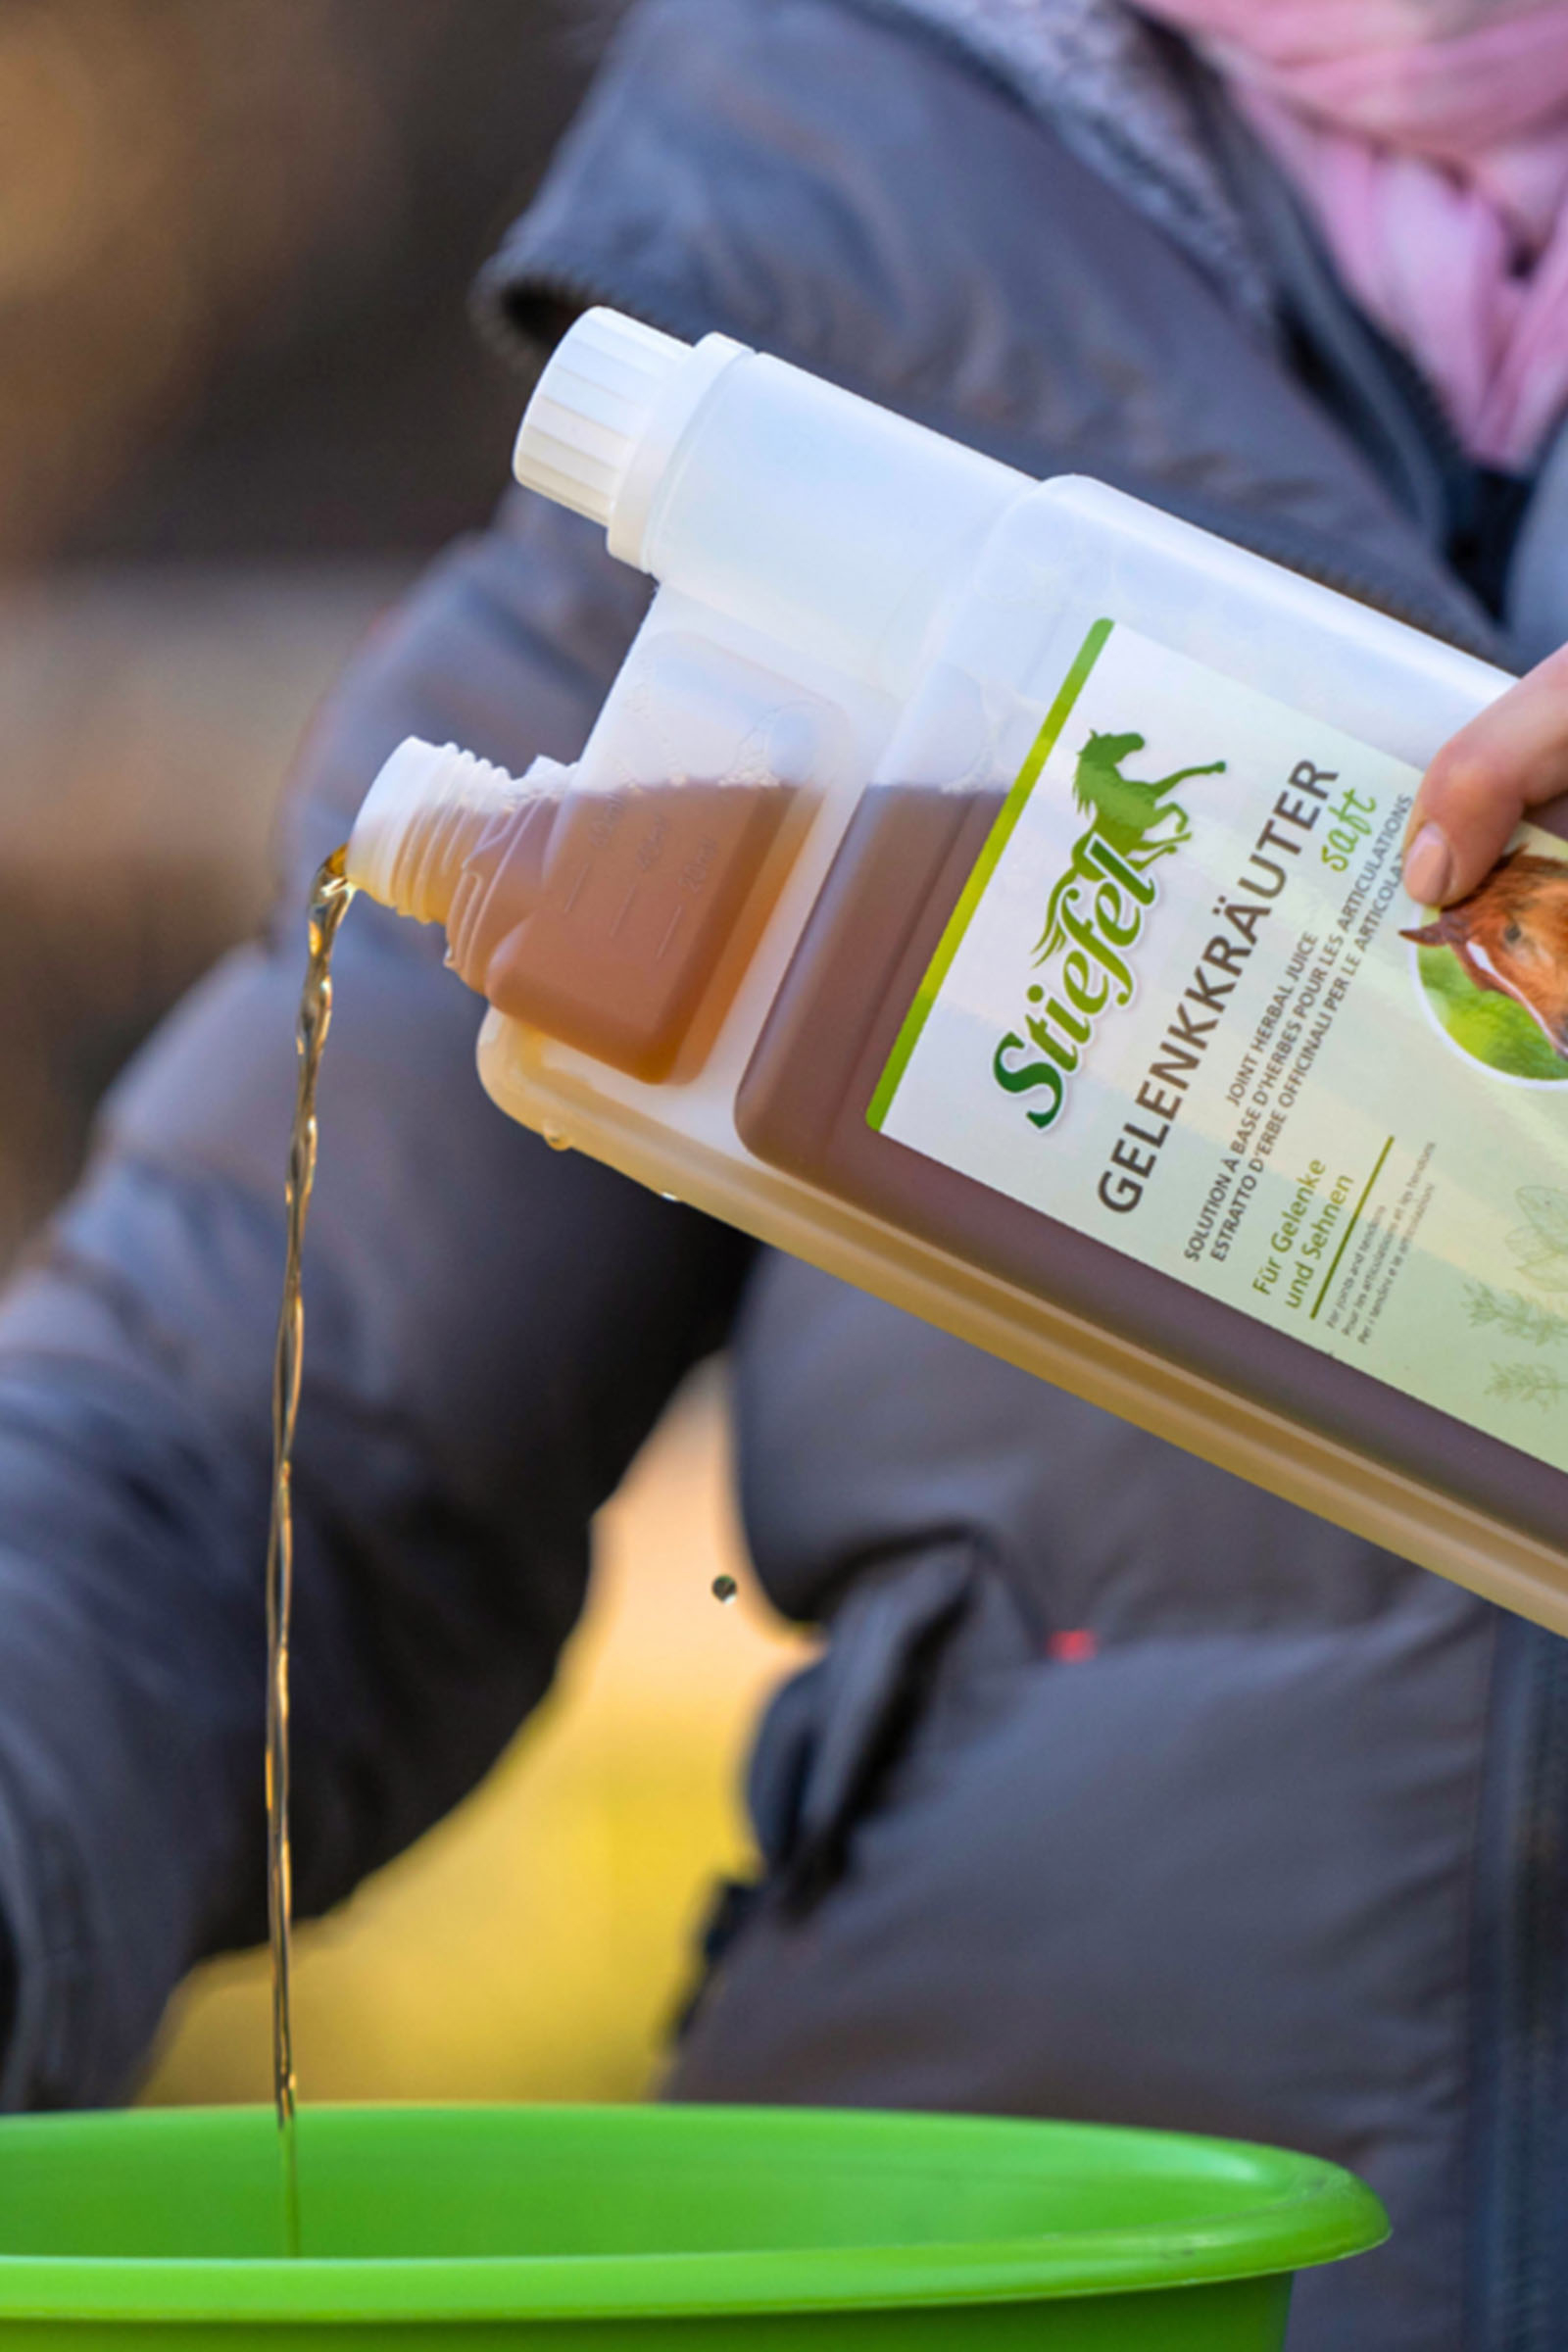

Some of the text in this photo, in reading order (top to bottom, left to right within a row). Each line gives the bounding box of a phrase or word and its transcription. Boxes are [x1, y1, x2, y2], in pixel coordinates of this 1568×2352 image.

[1320, 787, 1378, 872] saft
[1336, 795, 1412, 933] ARTICULATIONS
[992, 838, 1157, 1129] Stiefel
[1097, 760, 1339, 1214] GELENKKRÄUTER
[1292, 966, 1329, 1020] POUR
[1317, 934, 1345, 967] LES
[1225, 931, 1319, 1107] JOINT HERBAL JUICE
[1209, 1174, 1258, 1262] ESTRATTO
[1277, 1011, 1333, 1109] OFFICINALI
[1322, 976, 1350, 1012] PER
[1340, 953, 1361, 977] LE
[1217, 1154, 1242, 1175] À
[1229, 1116, 1258, 1155] BASE
[1183, 1172, 1233, 1262] SOLUTION
[1251, 1158, 1326, 1296] Für Gelenke
[1285, 1174, 1354, 1309] und Sehnen
